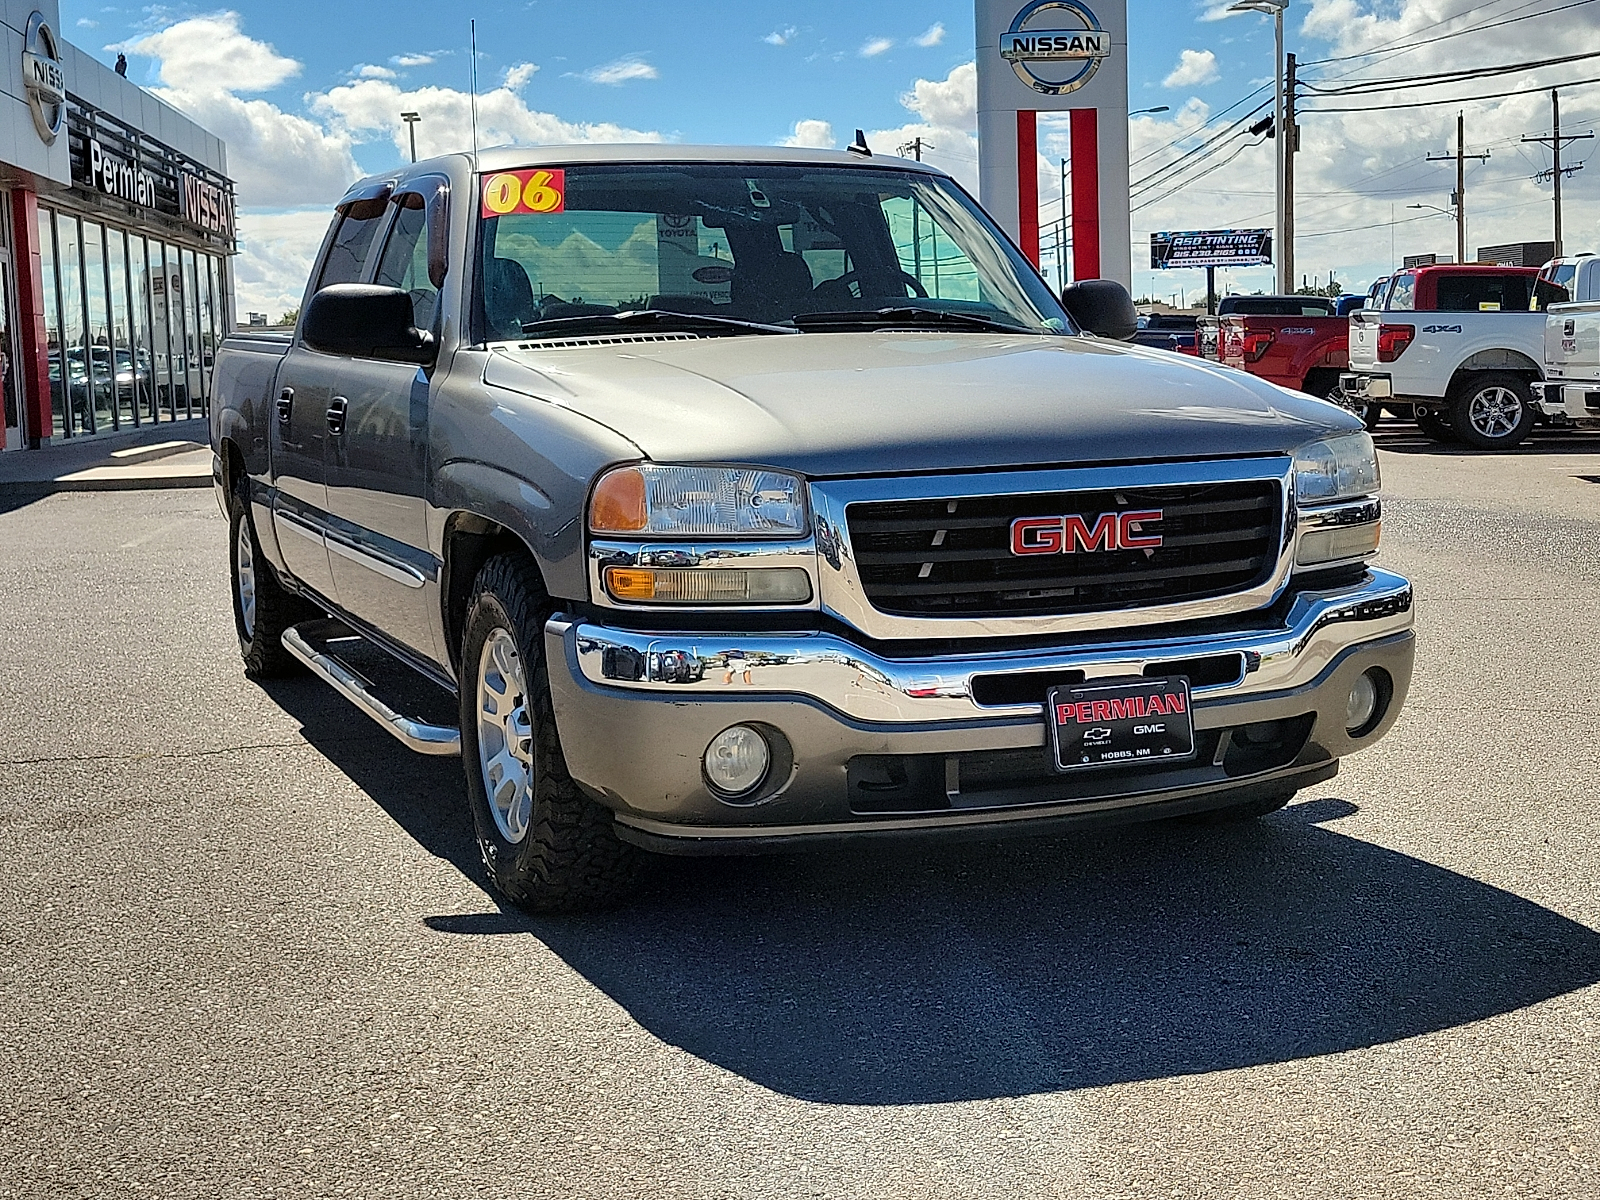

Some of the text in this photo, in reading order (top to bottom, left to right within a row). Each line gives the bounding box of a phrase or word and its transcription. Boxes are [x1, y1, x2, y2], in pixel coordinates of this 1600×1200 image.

[1013, 36, 1100, 52] NISSAN
[33, 59, 64, 90] NISS
[90, 139, 156, 209] Permian
[483, 170, 562, 214] 06
[182, 171, 237, 239] NISSAN
[658, 229, 698, 238] TOYOTA
[1205, 235, 1258, 244] TINTING
[1010, 508, 1163, 556] GMC
[1056, 692, 1186, 725] PERMIAN
[1133, 723, 1166, 735] GMC
[1083, 739, 1112, 747] CHEVROLET
[1101, 748, 1151, 760] HOBBS, NM
